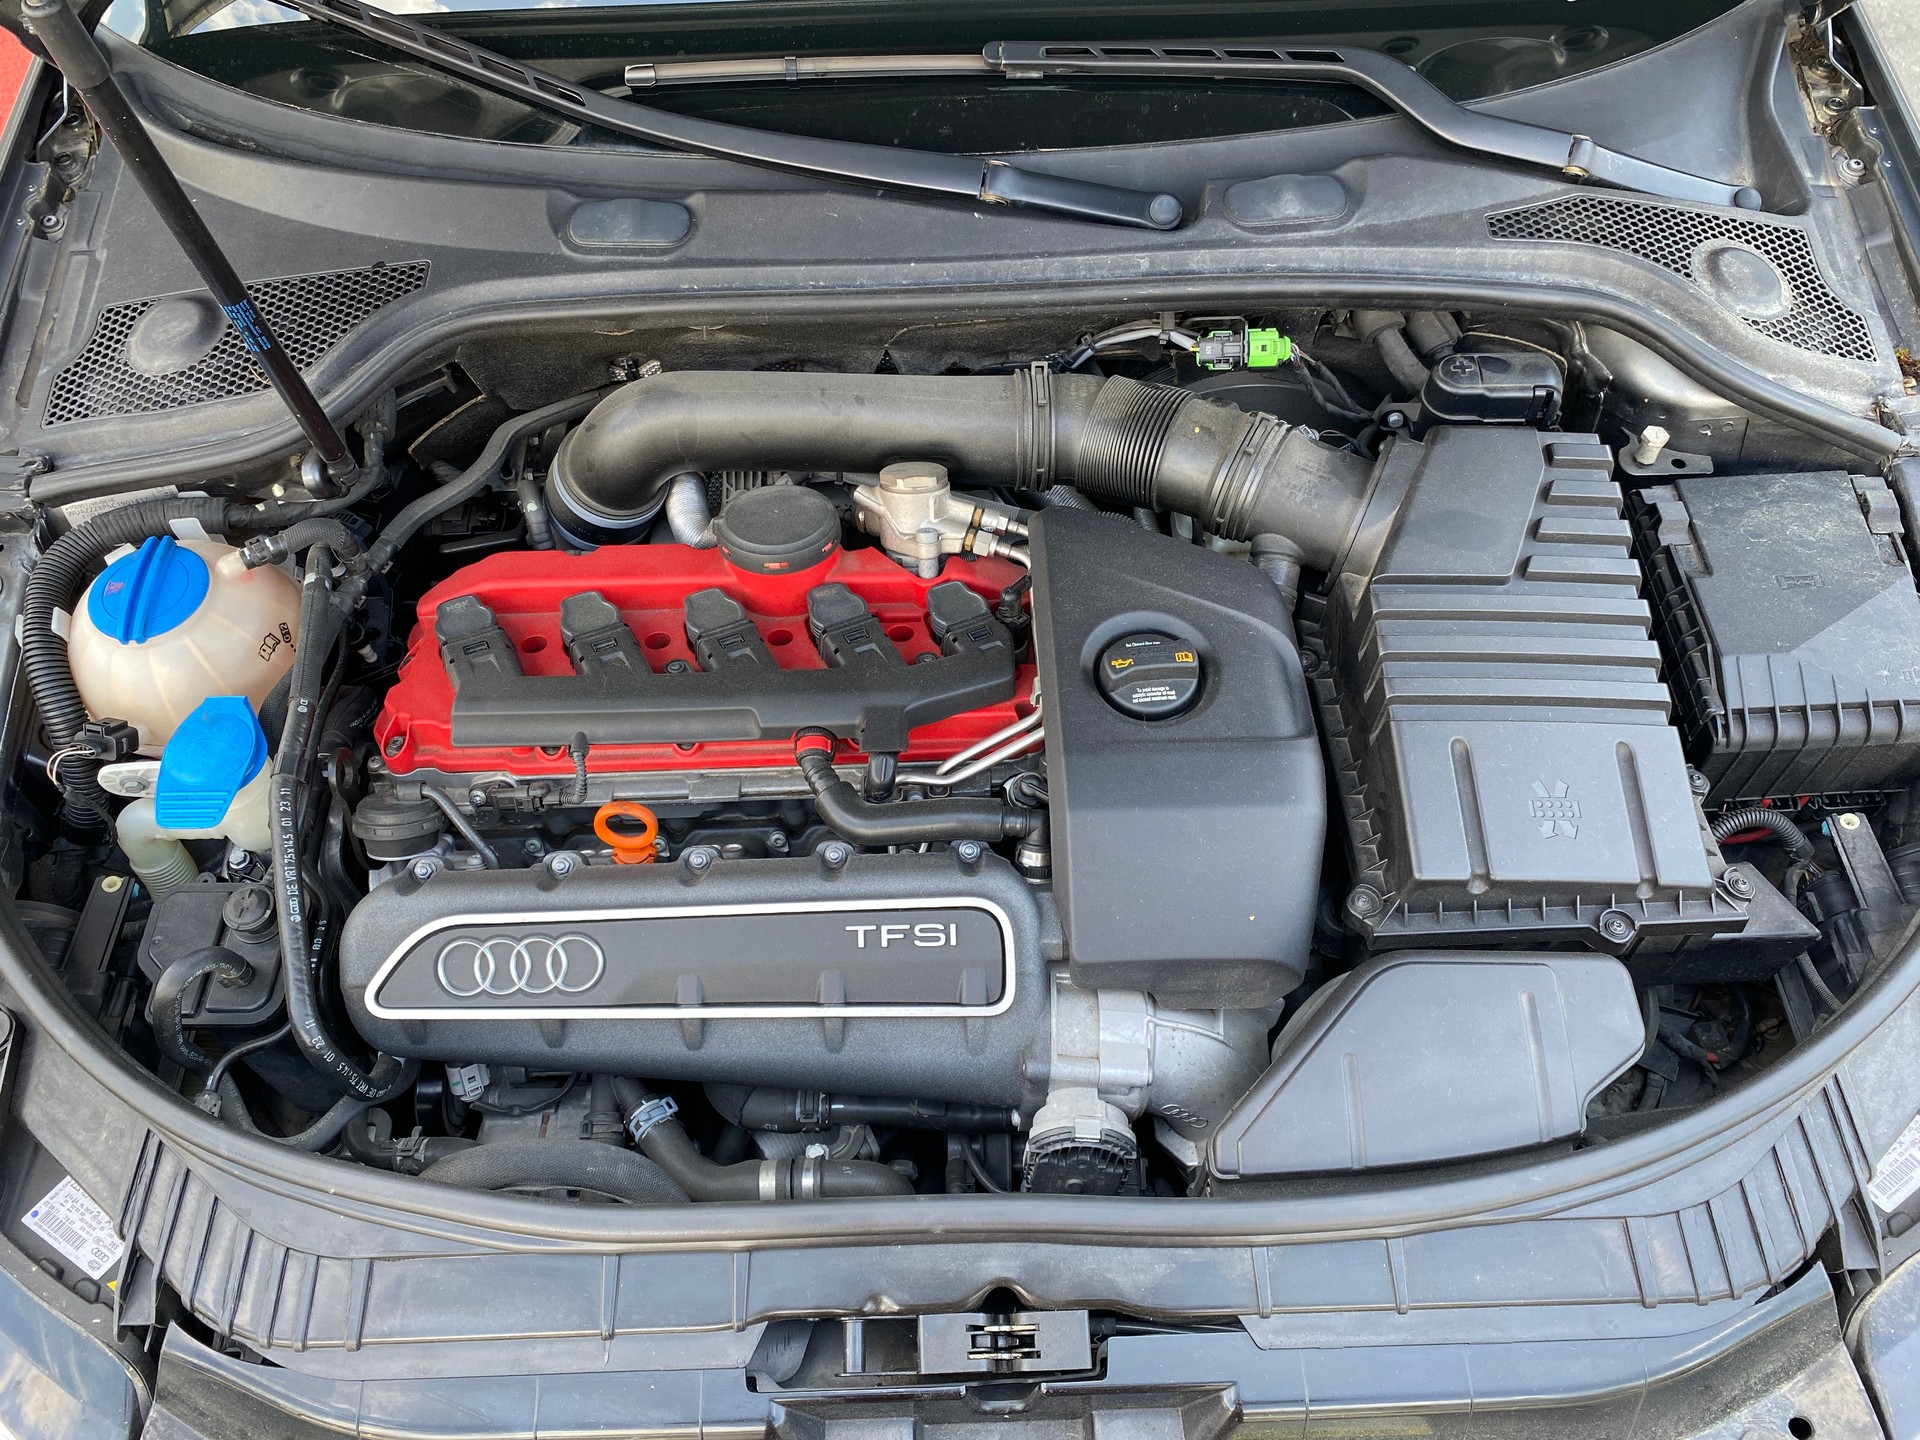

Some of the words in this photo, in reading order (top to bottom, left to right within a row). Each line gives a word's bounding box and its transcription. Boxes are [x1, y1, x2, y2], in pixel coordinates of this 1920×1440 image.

[280, 787, 291, 795] 11
[280, 801, 292, 811] 23
[281, 817, 292, 827] 01
[284, 866, 297, 882] VRT
[286, 883, 299, 896] DE
[845, 923, 957, 948] TFSI
[304, 1019, 316, 1029] 11
[312, 1035, 326, 1049] 23
[323, 1050, 336, 1062] 01
